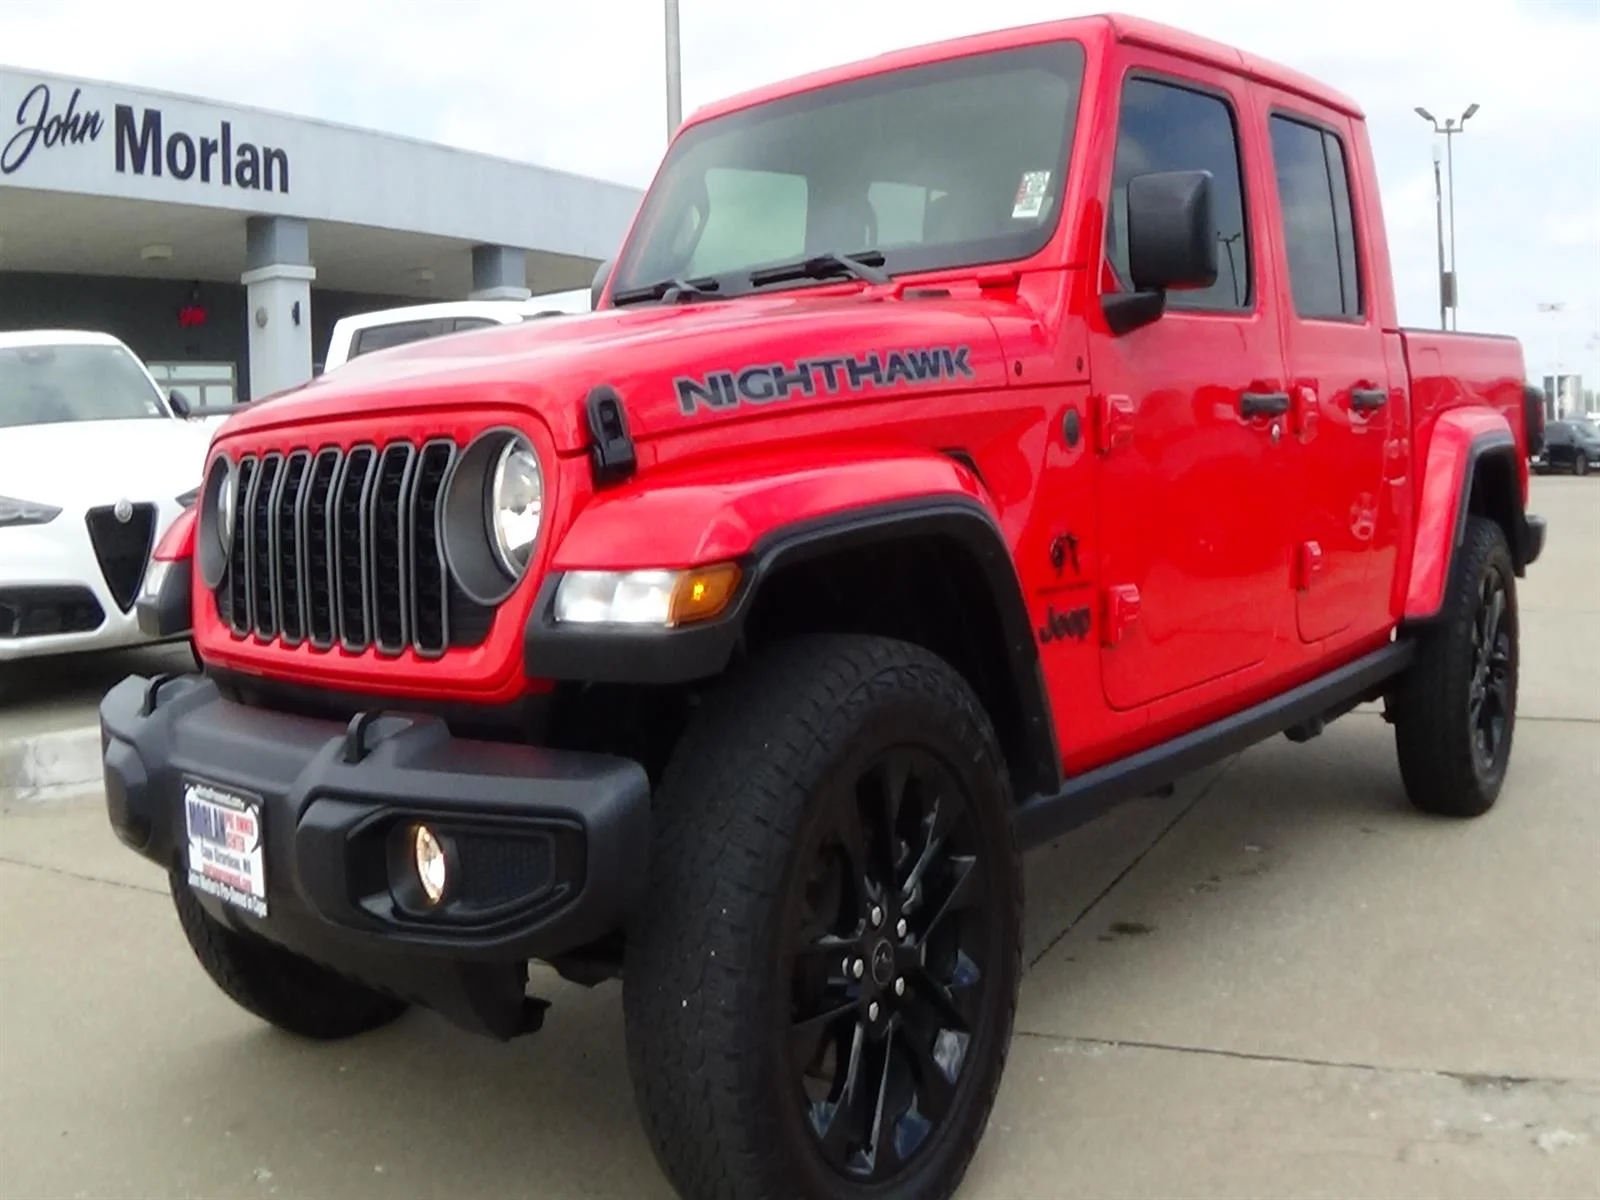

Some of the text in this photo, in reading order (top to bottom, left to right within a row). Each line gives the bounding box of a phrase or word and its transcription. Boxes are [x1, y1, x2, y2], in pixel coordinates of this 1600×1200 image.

[1, 84, 289, 193] John Morlan
[672, 345, 973, 414] NIGHTHAWK
[1039, 603, 1091, 644] Jeep
